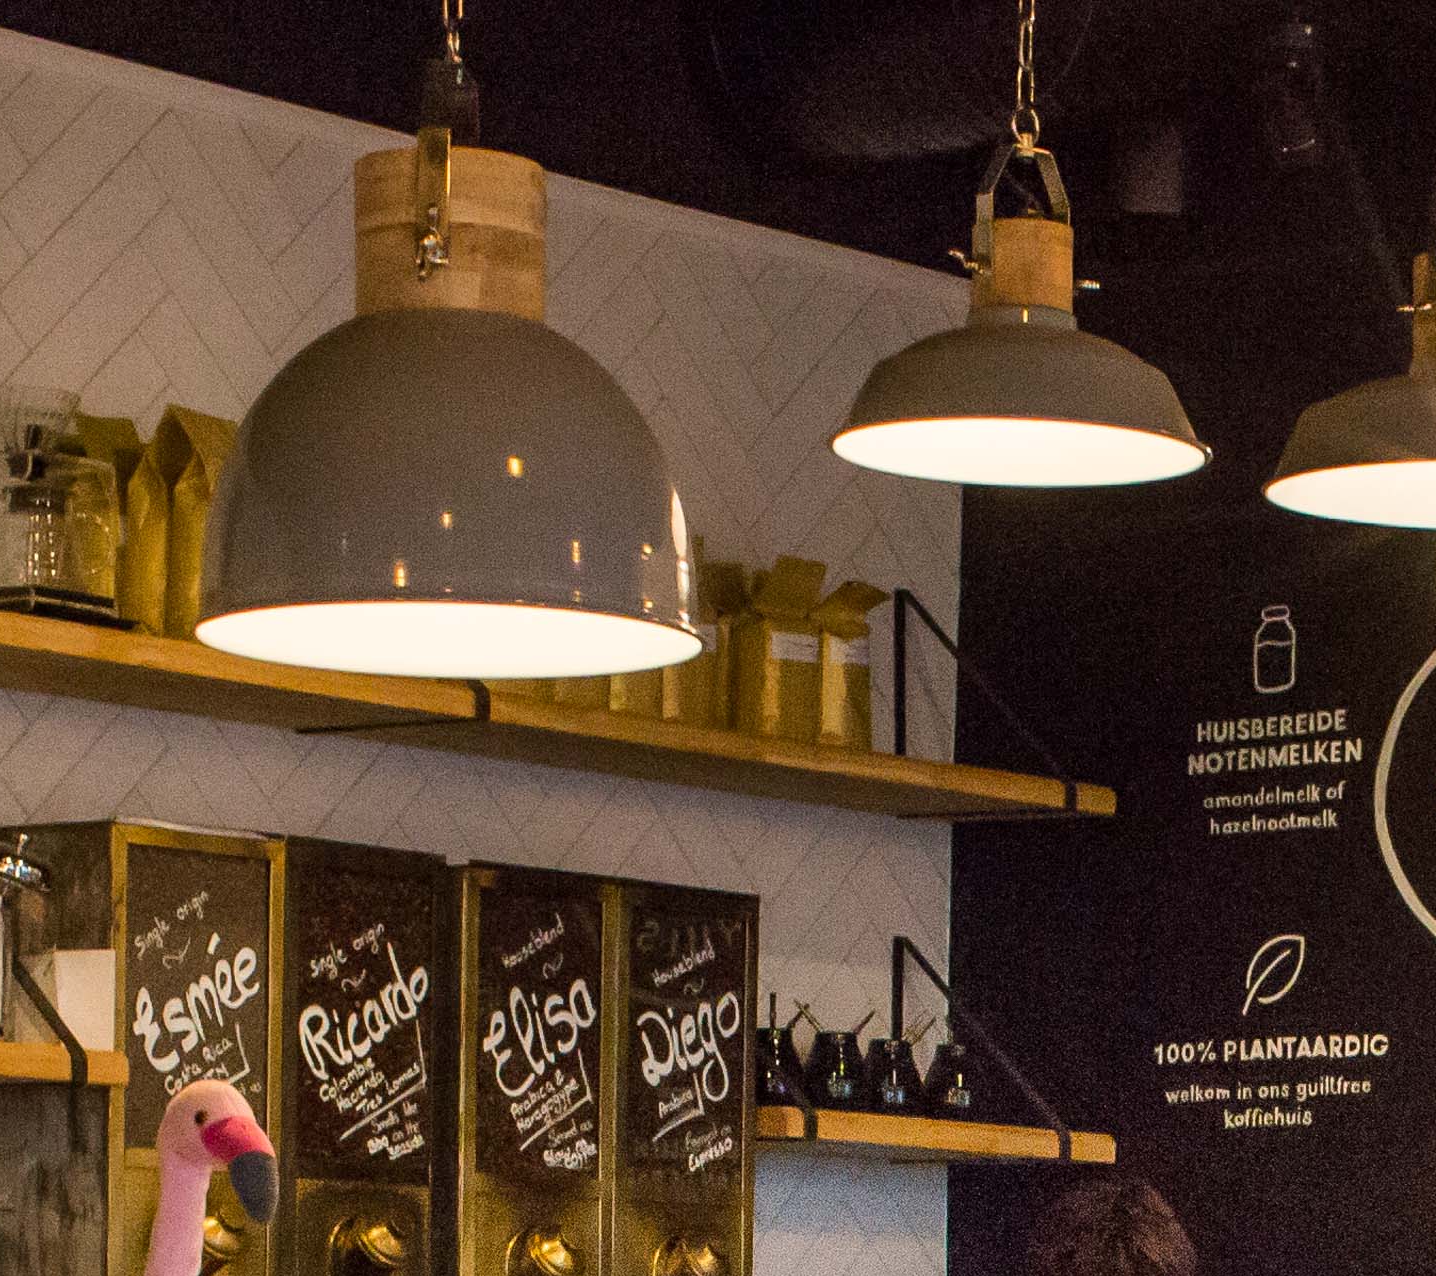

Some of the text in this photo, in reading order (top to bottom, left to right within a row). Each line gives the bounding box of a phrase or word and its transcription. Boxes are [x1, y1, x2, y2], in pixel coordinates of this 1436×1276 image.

[1197, 708, 1349, 743] HUISBEREIDE
[1188, 738, 1363, 775] NOTENMELKEN
[1203, 780, 1346, 809] amandelmelk of
[1210, 809, 1339, 835] hazelnootmelk
[132, 932, 261, 1073] Esmée
[299, 941, 428, 1081] Ricardo
[483, 978, 596, 1097] Elisa
[636, 990, 740, 1102] Diego
[1154, 1033, 1389, 1065] 100% PLANTAARDIG
[1165, 1075, 1372, 1105] welkom in ons guiltfree
[1224, 1106, 1313, 1129] koffiehuis
